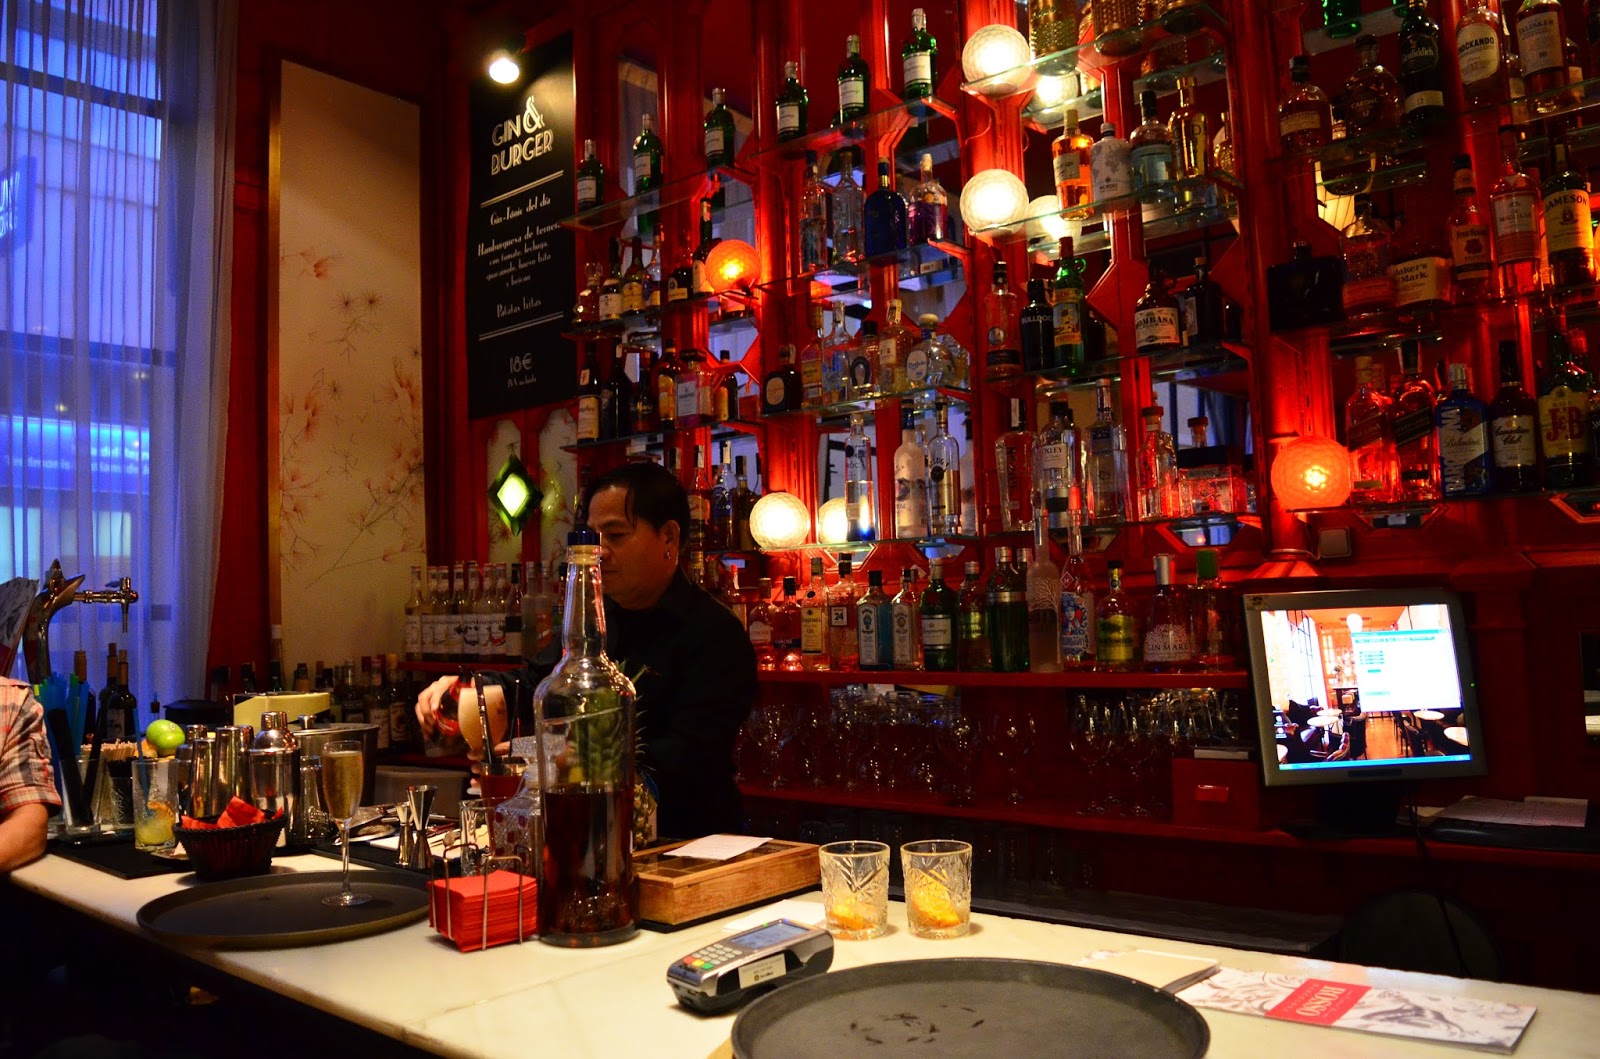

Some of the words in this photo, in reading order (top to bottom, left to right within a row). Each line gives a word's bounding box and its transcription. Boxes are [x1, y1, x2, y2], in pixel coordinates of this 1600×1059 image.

[1459, 36, 1495, 53] NOCKANDO
[491, 114, 521, 147] GIN
[523, 95, 546, 134] &
[1362, 110, 1370, 118] 12
[491, 128, 554, 176] BURGER
[526, 195, 538, 213] del
[1545, 194, 1587, 212] JAMESON
[477, 235, 522, 257] Hamburguesa
[524, 225, 534, 240] de
[1401, 271, 1428, 282] Mark
[497, 303, 521, 319] Patatas
[509, 352, 532, 374] 18€
[1546, 406, 1584, 442] J&B
[1441, 406, 1465, 492] BARCNA!
[835, 612, 844, 620] 24
[1148, 644, 1160, 652] GIN
[1296, 985, 1346, 1017] ROSSO
